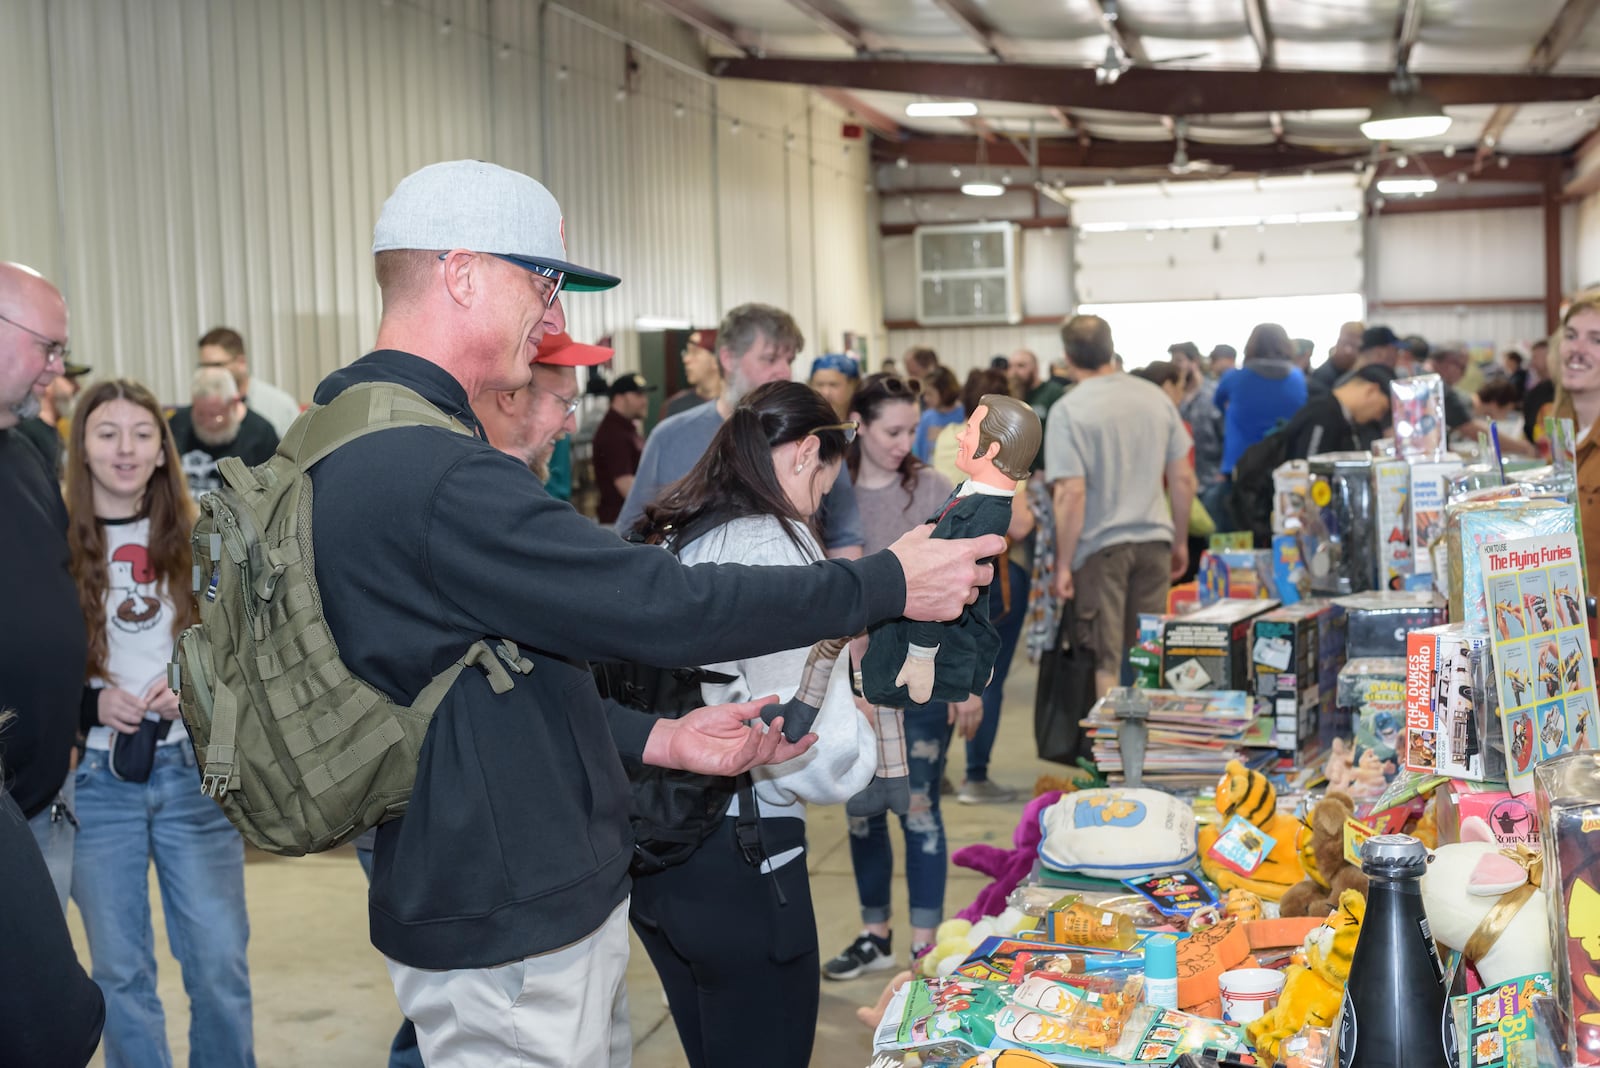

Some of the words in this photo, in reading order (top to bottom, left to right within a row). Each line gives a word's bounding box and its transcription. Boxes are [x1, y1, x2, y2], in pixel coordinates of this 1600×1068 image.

[1484, 545, 1493, 553] HOW
[1493, 544, 1499, 552] TO
[1499, 543, 1507, 552] USE
[1489, 554, 1508, 571] The
[1509, 550, 1540, 571] Flying
[1541, 545, 1572, 563] Furies
[1409, 654, 1420, 697] DUKES
[1419, 645, 1431, 707] HAZZARD
[1408, 701, 1419, 727] THE
[1418, 710, 1430, 728] OF
